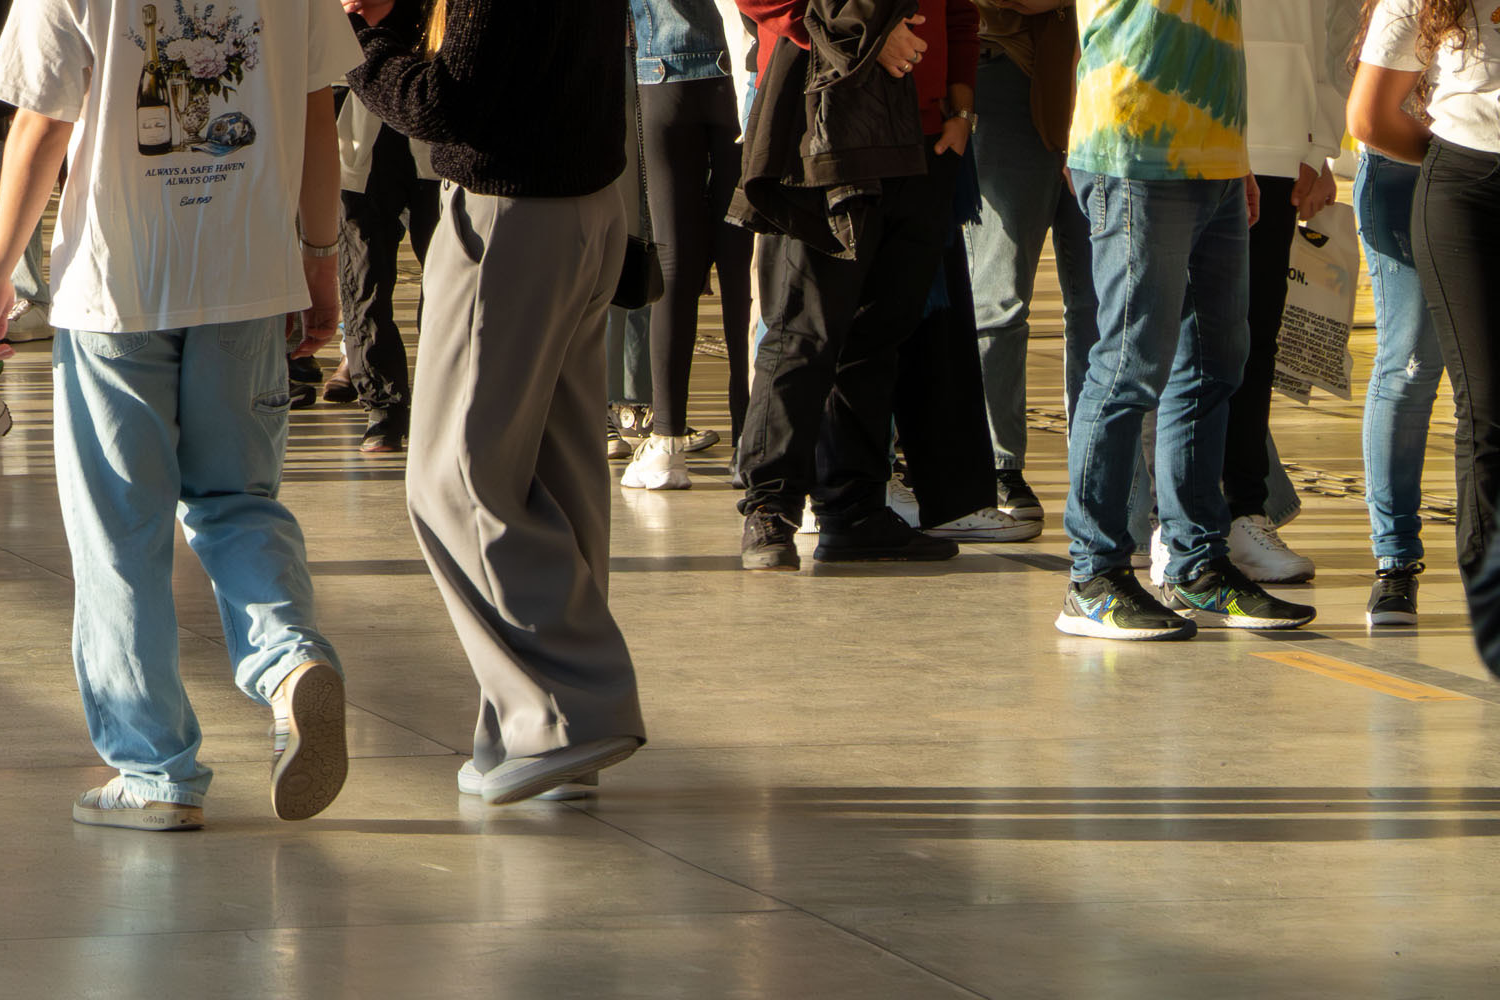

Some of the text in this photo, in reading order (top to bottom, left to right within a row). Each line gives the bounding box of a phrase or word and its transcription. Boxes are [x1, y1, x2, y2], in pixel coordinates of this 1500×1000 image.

[145, 162, 245, 177] ALWAYS A SAFE HAVEN
[165, 174, 227, 186] ALWAYS OPEN
